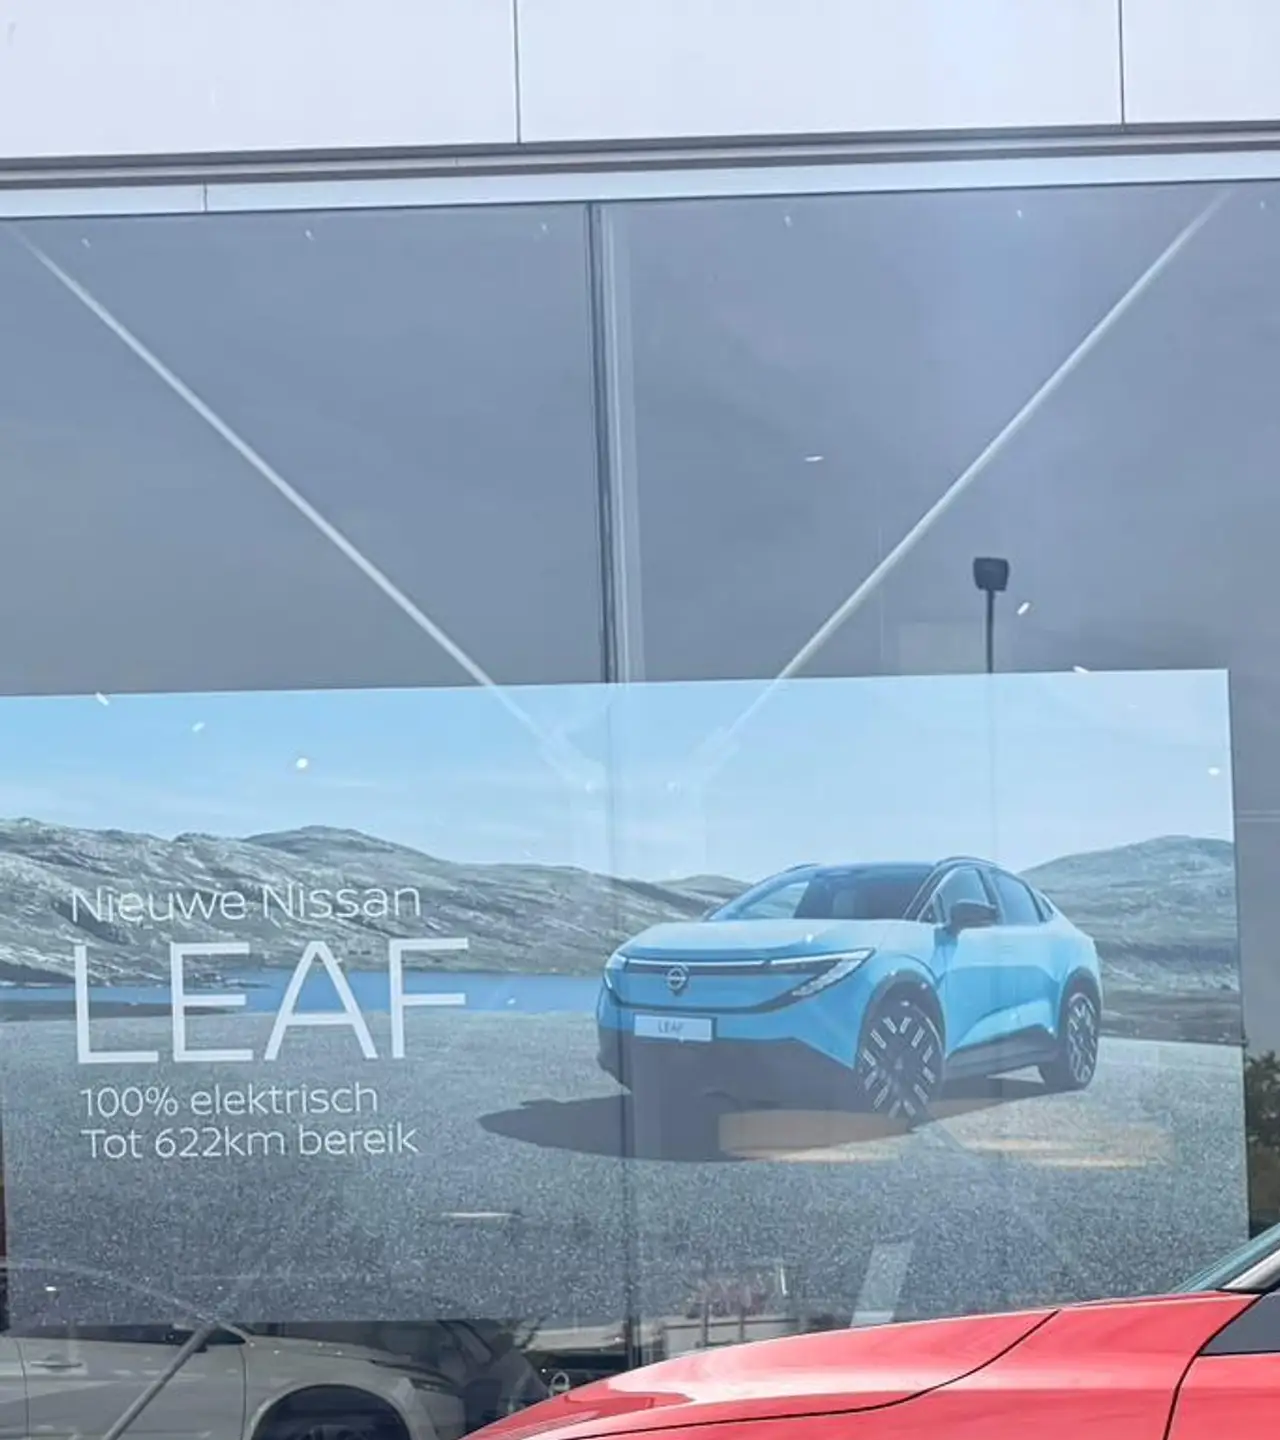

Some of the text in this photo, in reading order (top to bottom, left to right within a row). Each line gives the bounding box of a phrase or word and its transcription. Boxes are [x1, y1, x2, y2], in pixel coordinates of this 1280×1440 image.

[71, 882, 422, 923] Nieuwe Nissan
[73, 936, 470, 1065] LEAF
[79, 1082, 378, 1118] 100% elektrisch
[80, 1121, 420, 1159] Tot 622km bereik
